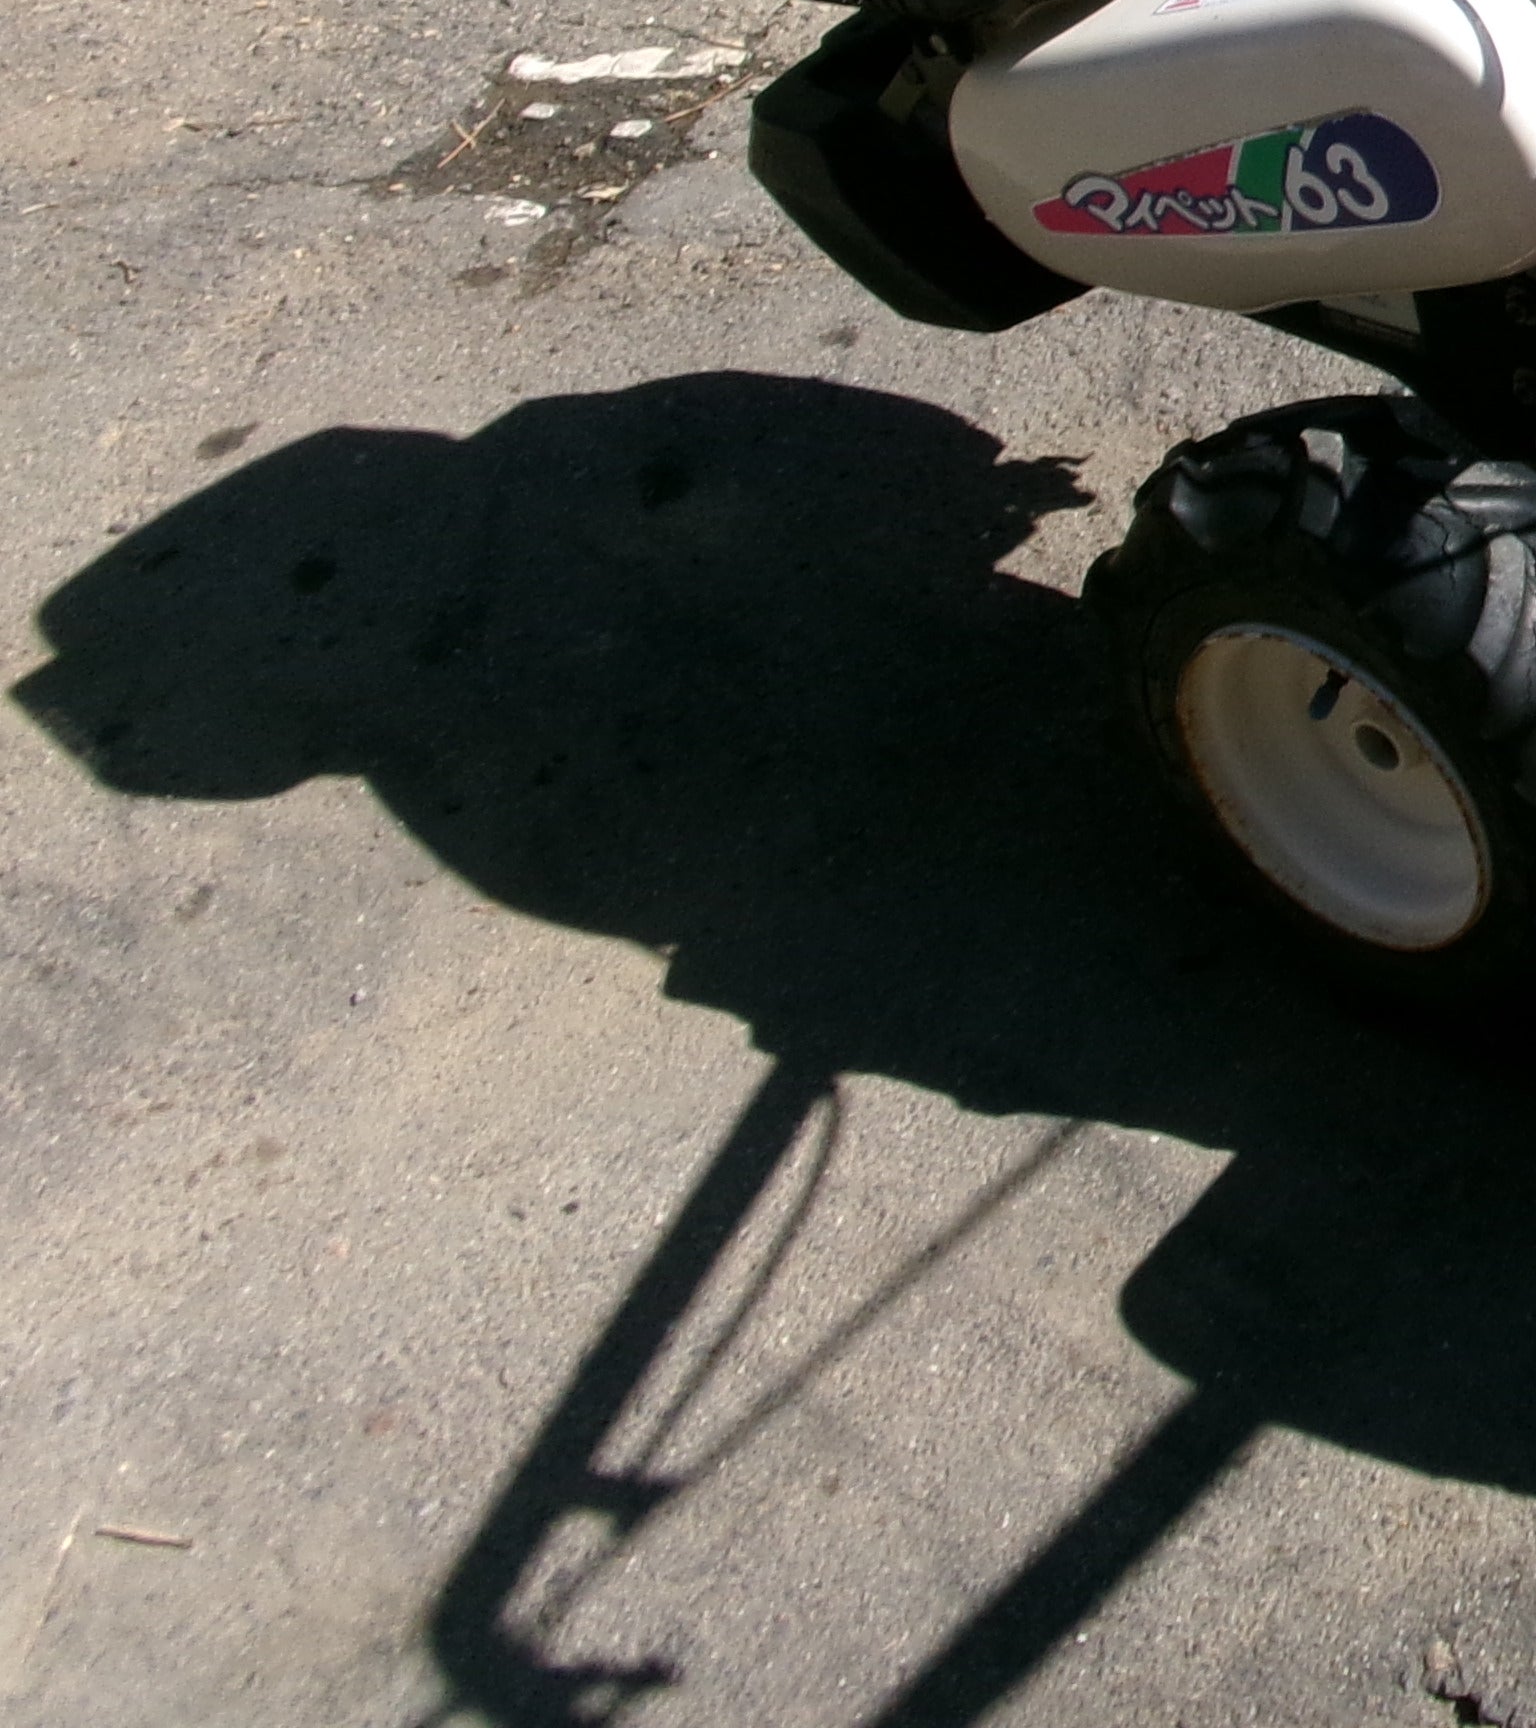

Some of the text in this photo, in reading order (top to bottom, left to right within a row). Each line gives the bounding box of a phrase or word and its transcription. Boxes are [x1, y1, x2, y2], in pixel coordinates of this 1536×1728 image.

[1062, 142, 1390, 232] マイペット 63
